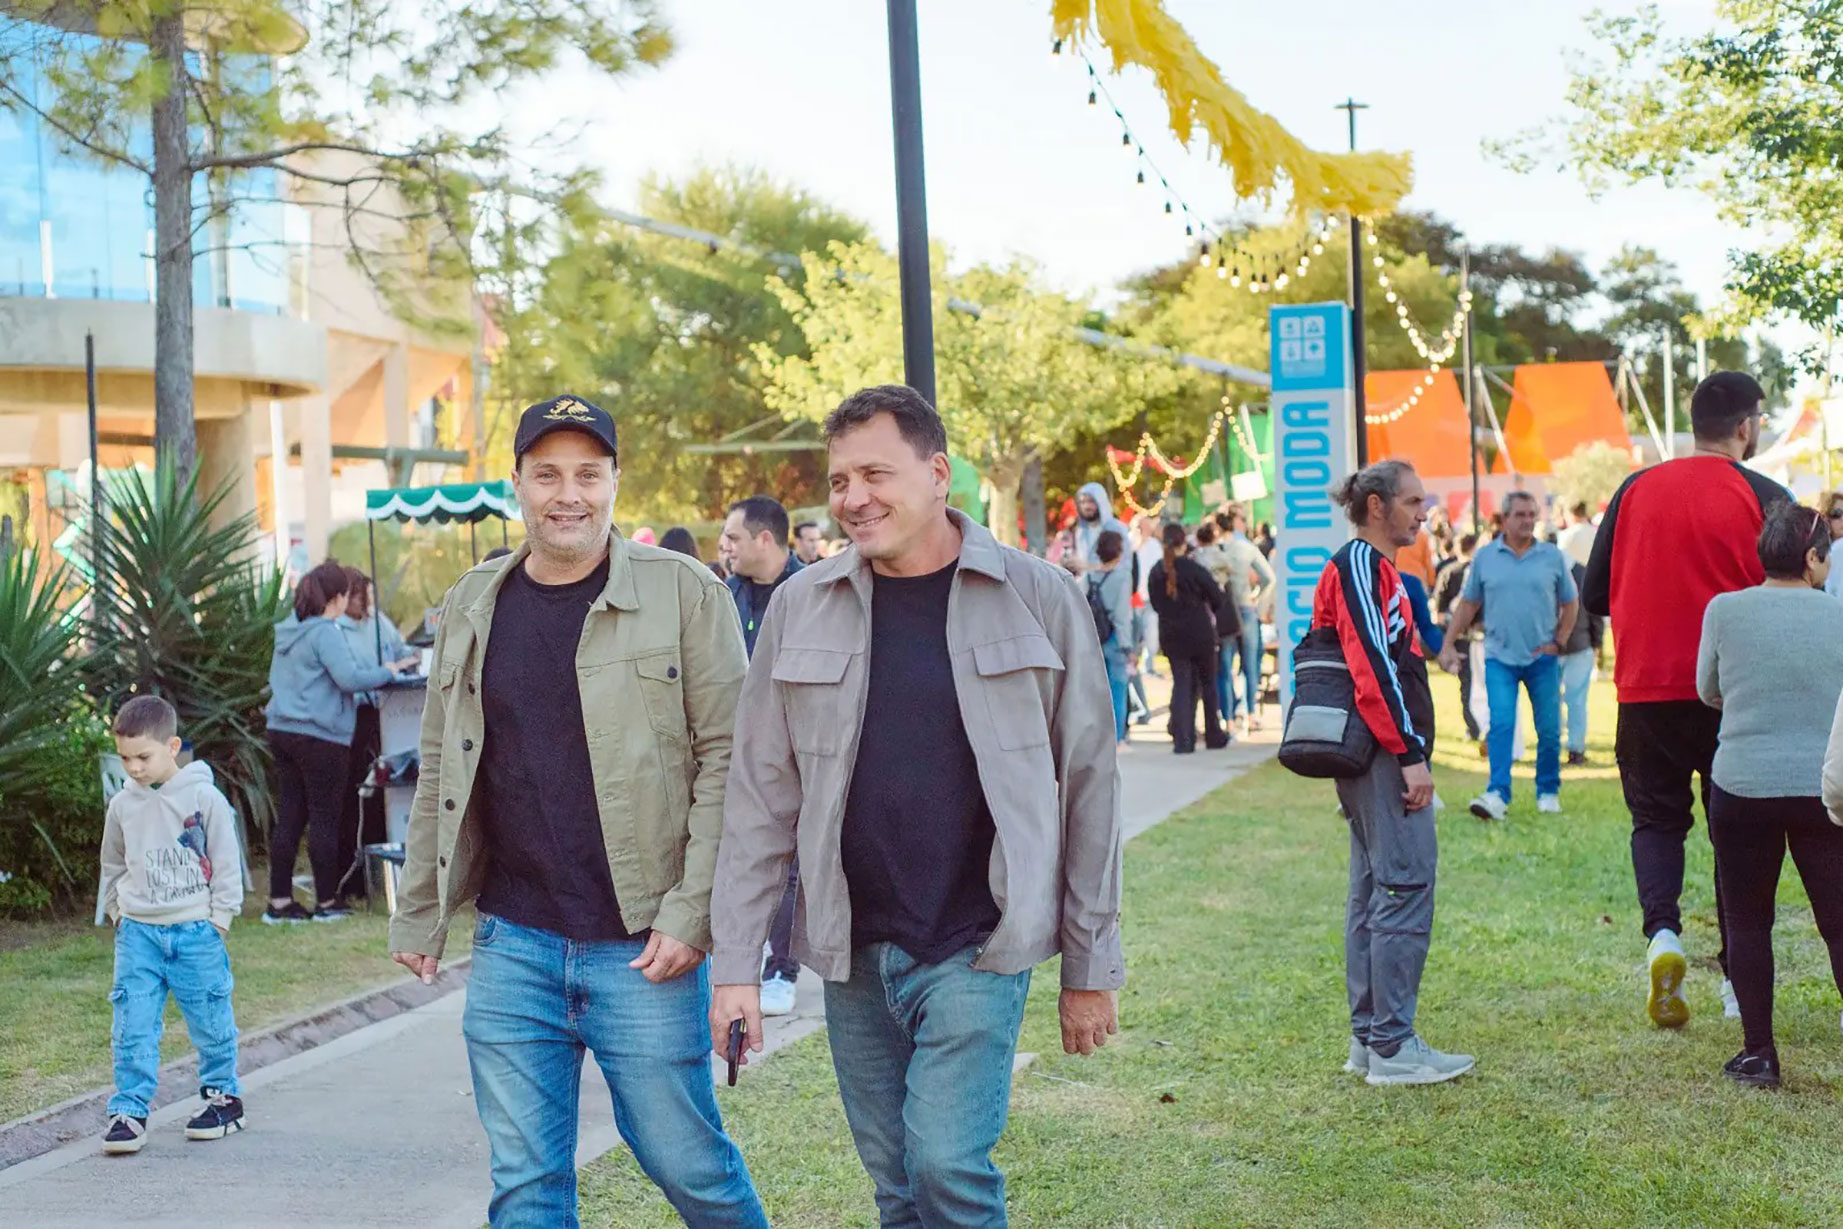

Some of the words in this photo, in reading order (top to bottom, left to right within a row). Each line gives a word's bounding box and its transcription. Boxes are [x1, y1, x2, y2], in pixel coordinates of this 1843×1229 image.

[1281, 400, 1332, 529] MODA
[146, 847, 190, 868] STAND
[146, 867, 178, 889] LOST
[186, 866, 199, 888] IN
